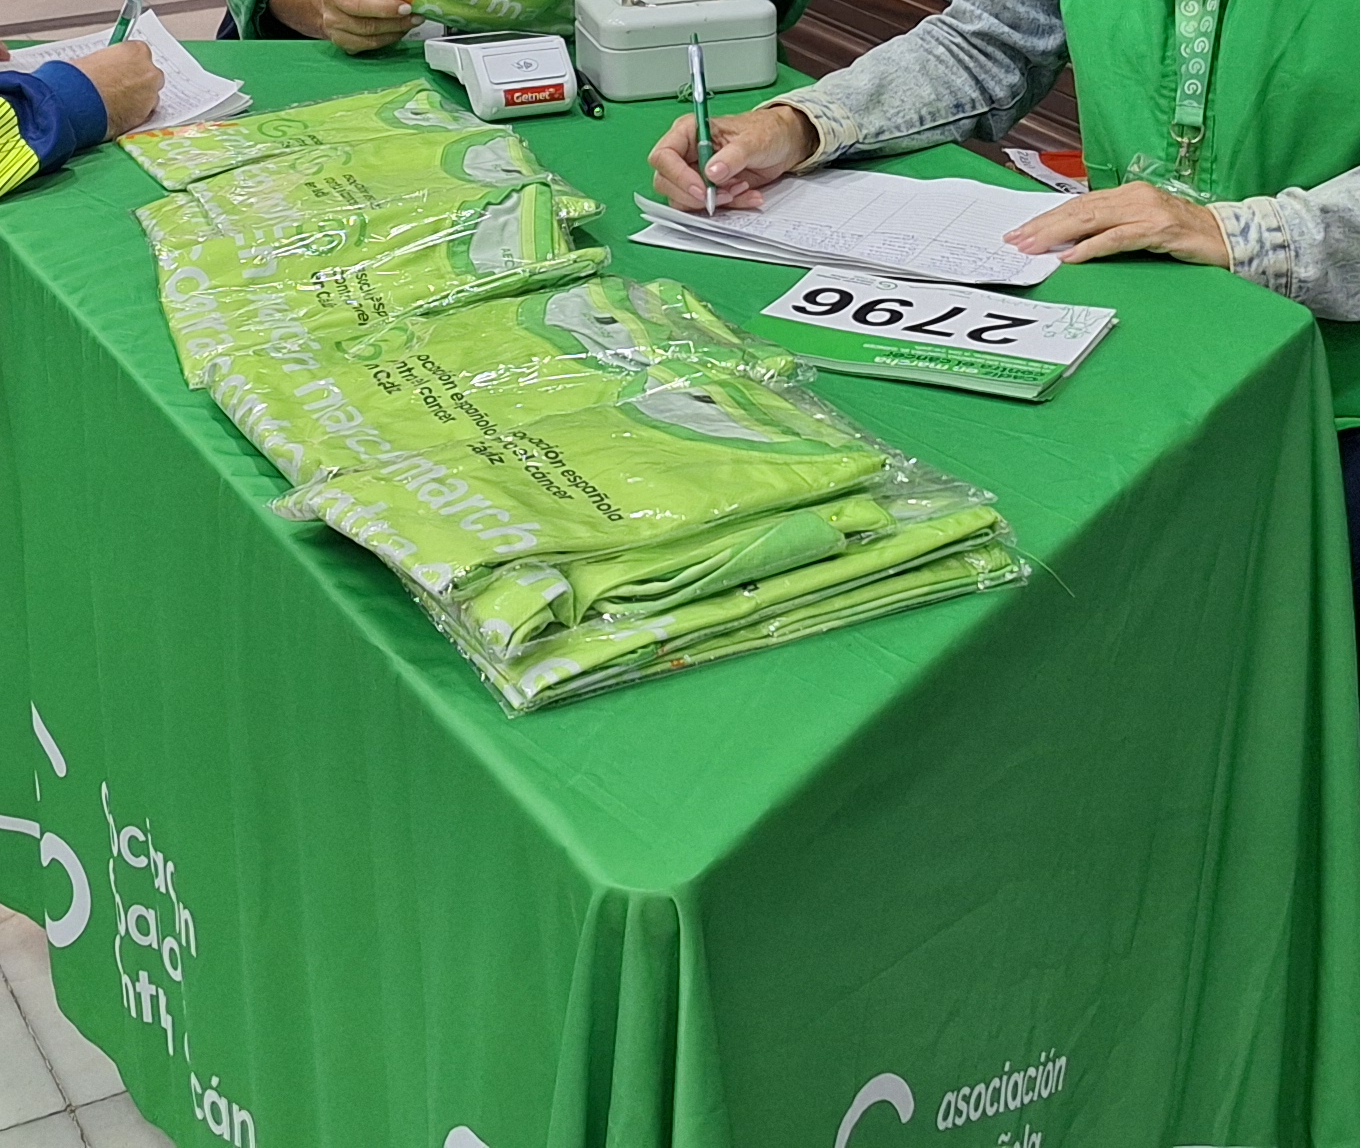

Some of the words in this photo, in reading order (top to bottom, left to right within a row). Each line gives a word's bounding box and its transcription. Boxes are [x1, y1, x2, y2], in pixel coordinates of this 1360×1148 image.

[513, 91, 551, 103] Getnet
[791, 286, 1040, 346] 2796
[523, 461, 576, 505] cáncer
[561, 466, 627, 524] española
[937, 1047, 1067, 1131] asociación
